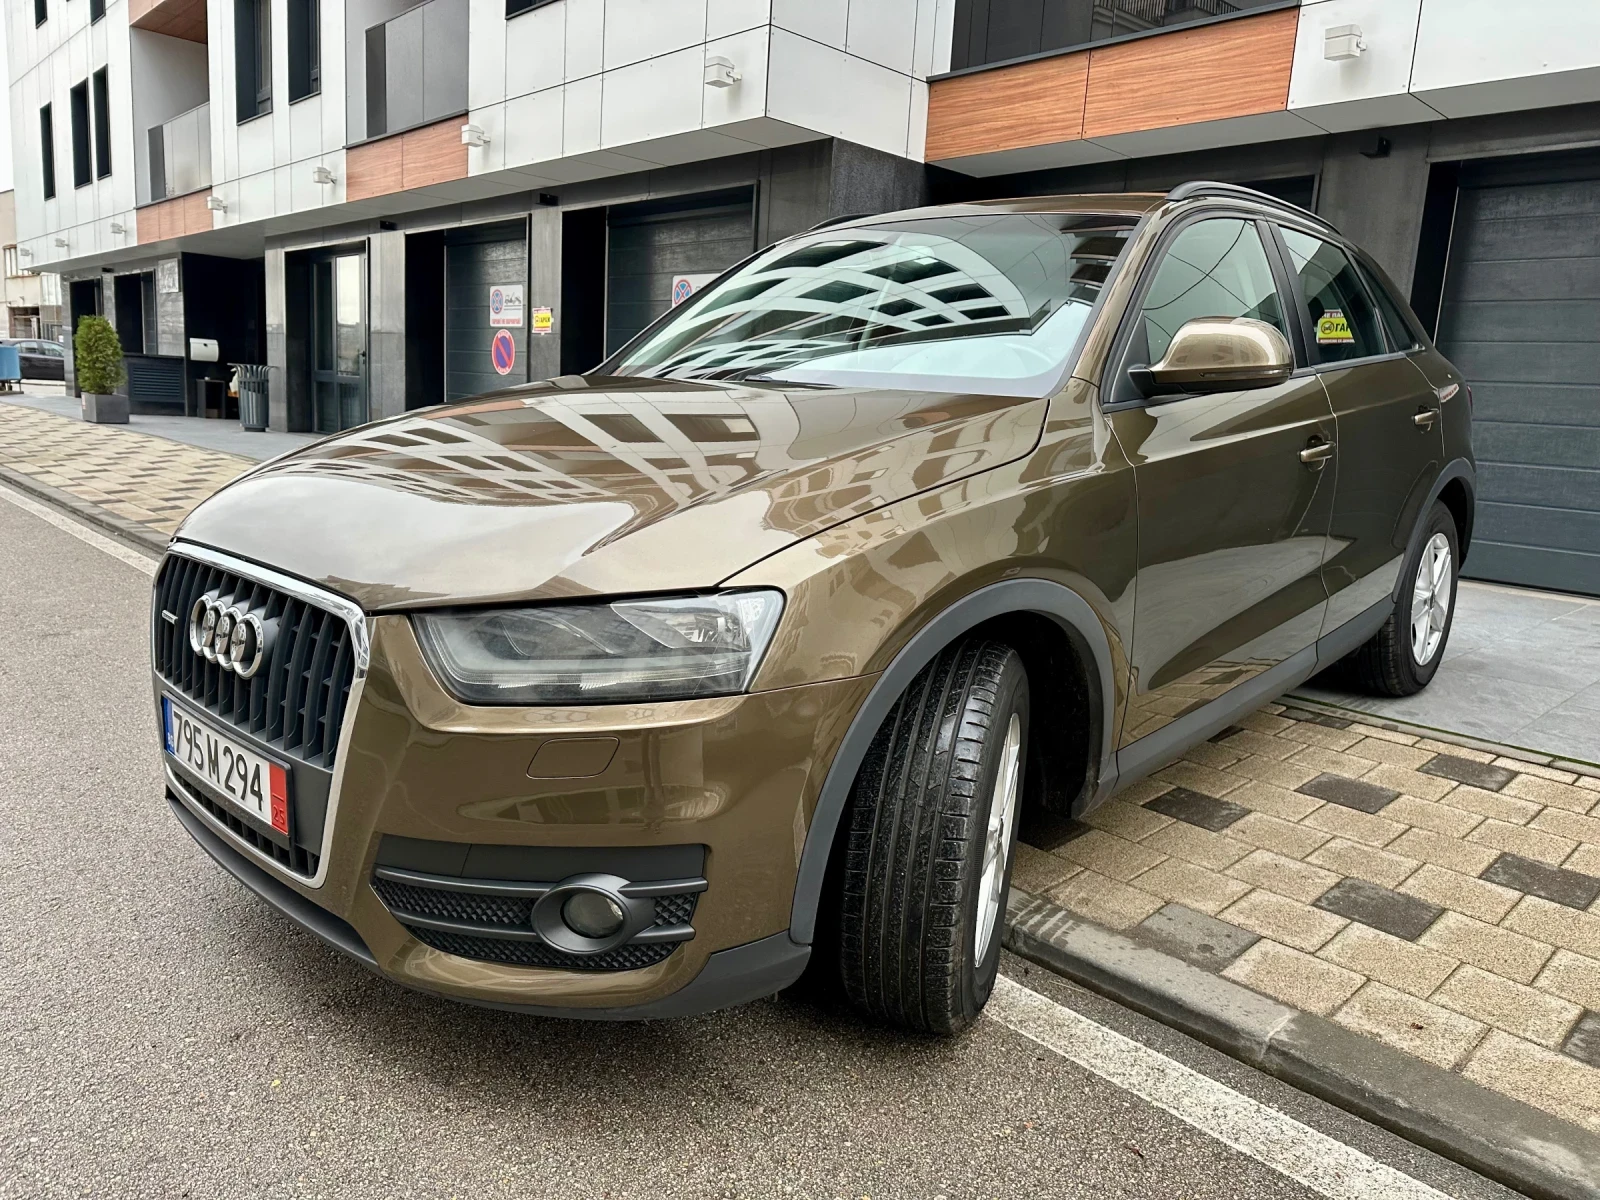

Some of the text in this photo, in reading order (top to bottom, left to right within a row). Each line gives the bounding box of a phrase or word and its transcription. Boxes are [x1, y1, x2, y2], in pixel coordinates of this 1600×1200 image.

[173, 710, 264, 812] 795 M 294
[273, 805, 285, 824] 25
